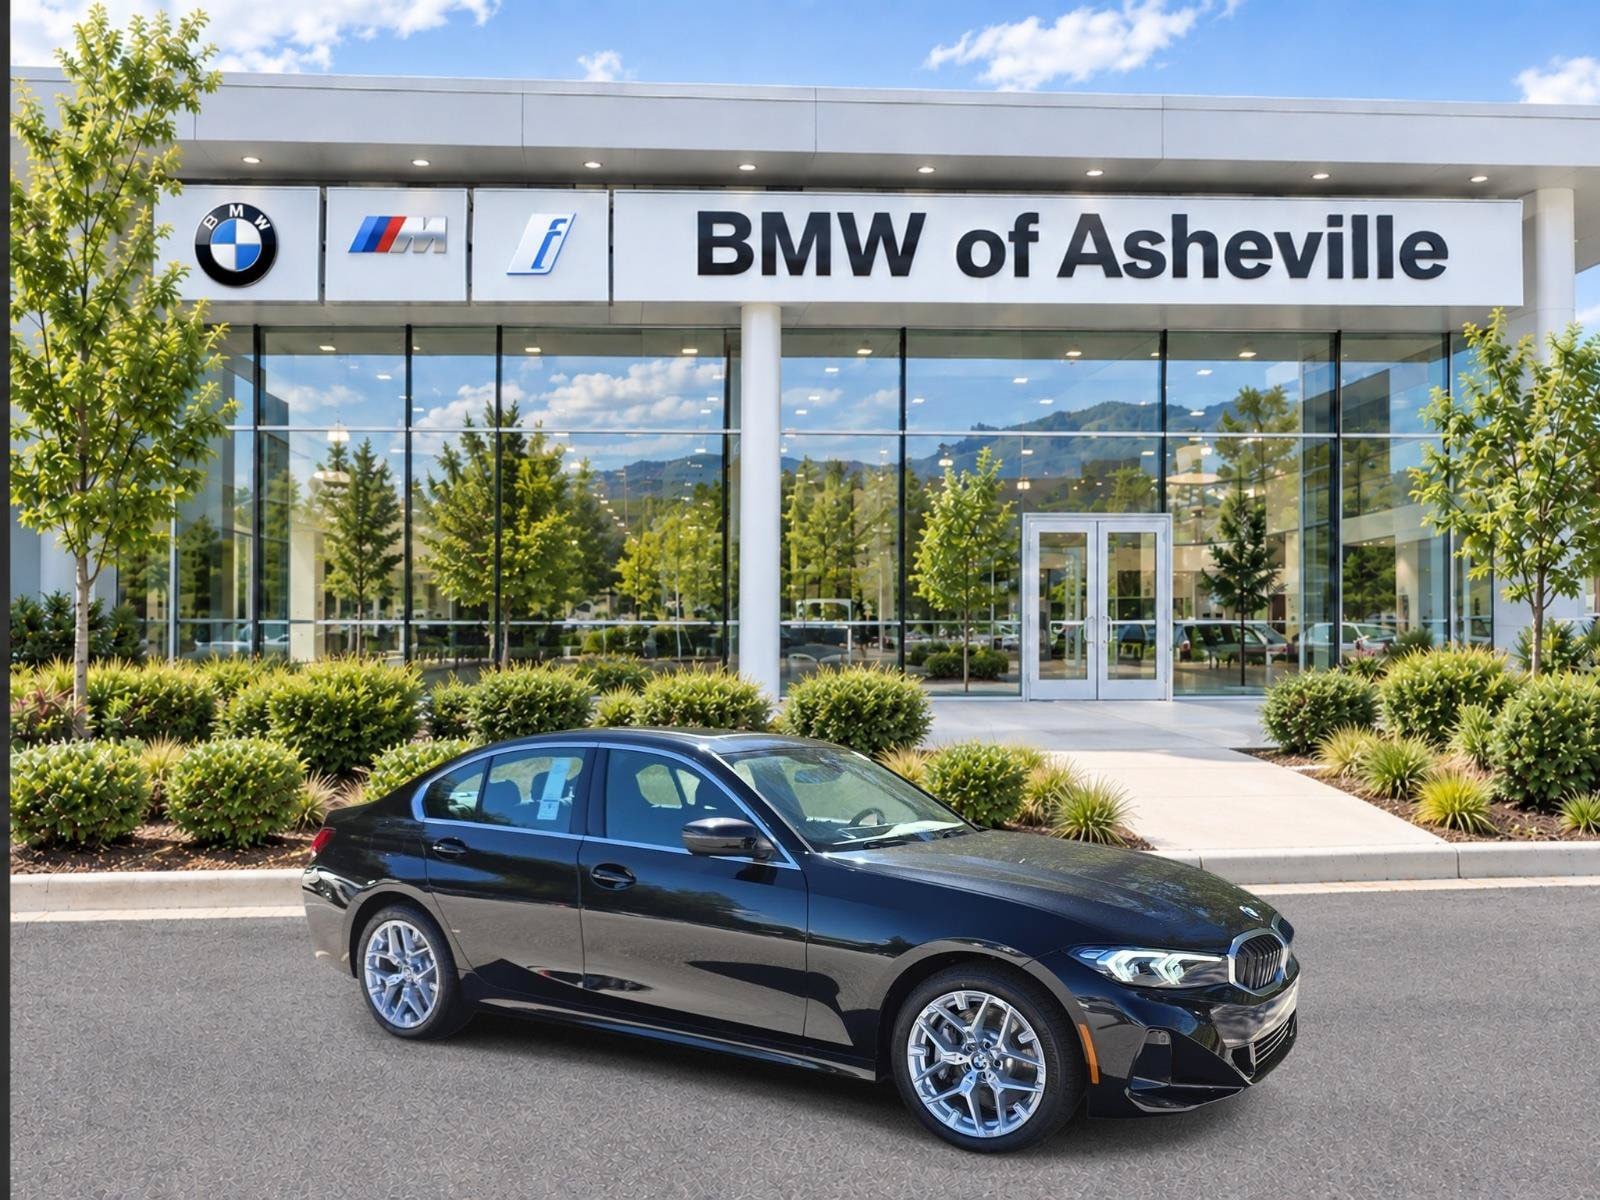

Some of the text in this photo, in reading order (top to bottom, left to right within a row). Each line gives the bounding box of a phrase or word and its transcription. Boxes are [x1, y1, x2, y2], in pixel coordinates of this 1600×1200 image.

[202, 204, 271, 230] BMW
[697, 210, 1449, 281] BMW of Asheville
